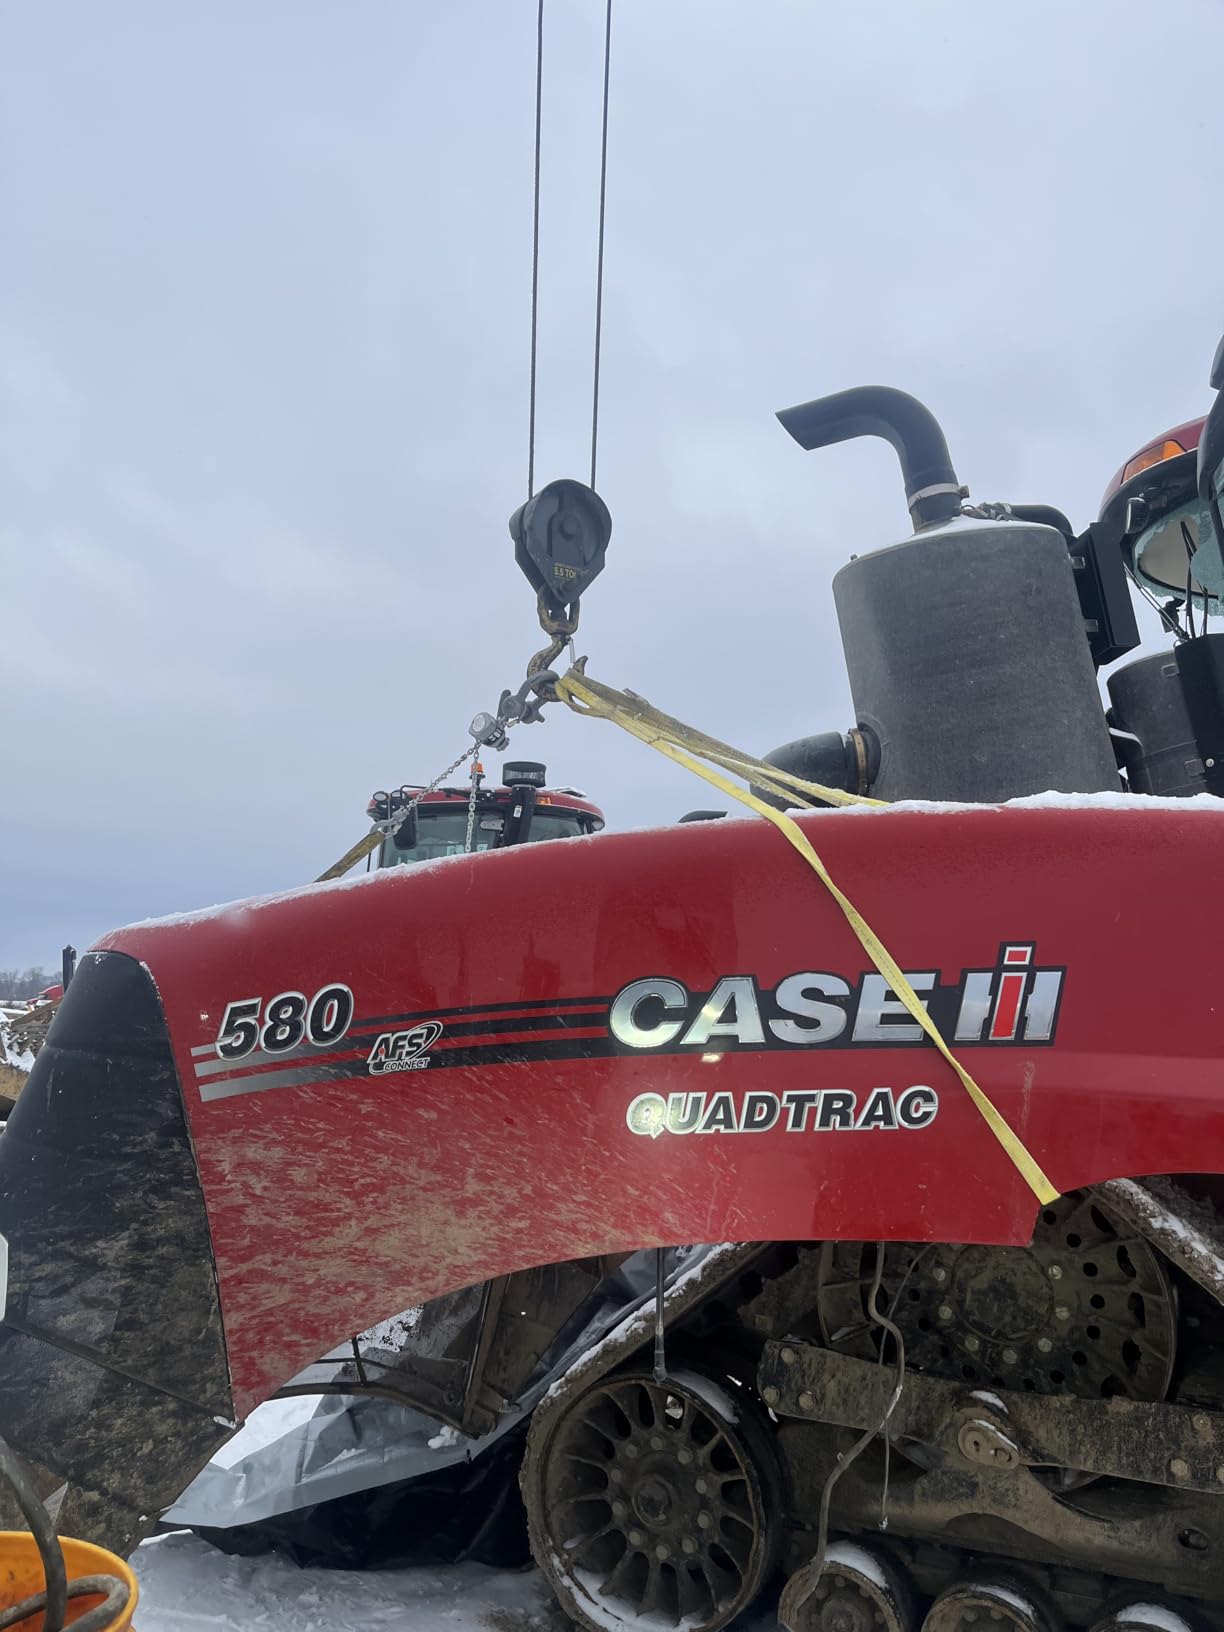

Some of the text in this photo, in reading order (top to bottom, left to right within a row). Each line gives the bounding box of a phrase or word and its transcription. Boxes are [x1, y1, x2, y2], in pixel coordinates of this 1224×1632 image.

[215, 983, 354, 1062] 580
[609, 971, 937, 1048] CASE
[367, 1028, 428, 1064] AFS
[384, 1057, 431, 1072] CONNECT
[626, 1085, 939, 1140] QUADTRAC
